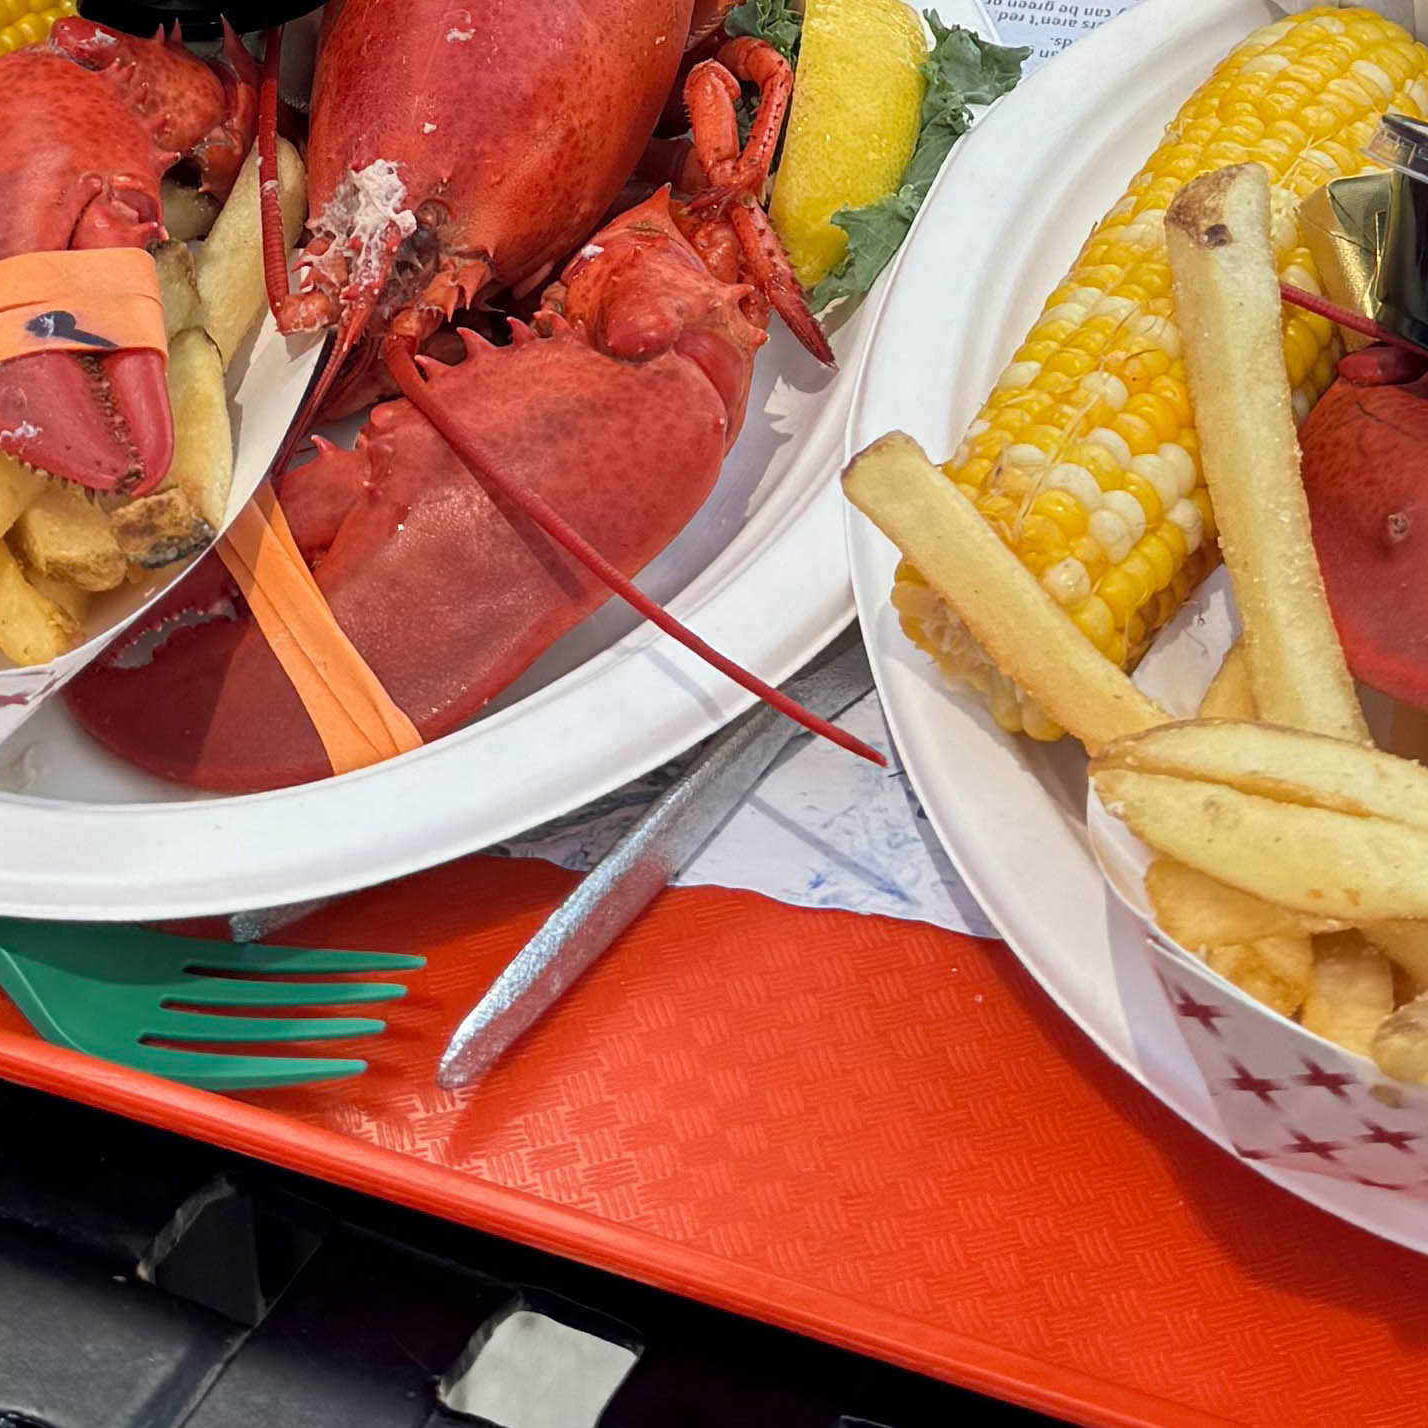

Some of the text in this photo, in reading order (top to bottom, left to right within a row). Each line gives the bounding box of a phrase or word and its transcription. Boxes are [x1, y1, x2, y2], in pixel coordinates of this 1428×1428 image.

[1007, 0, 1054, 14] green
[1058, 5, 1079, 18] be
[1083, 7, 1112, 19] can
[1028, 15, 1078, 30] aren't
